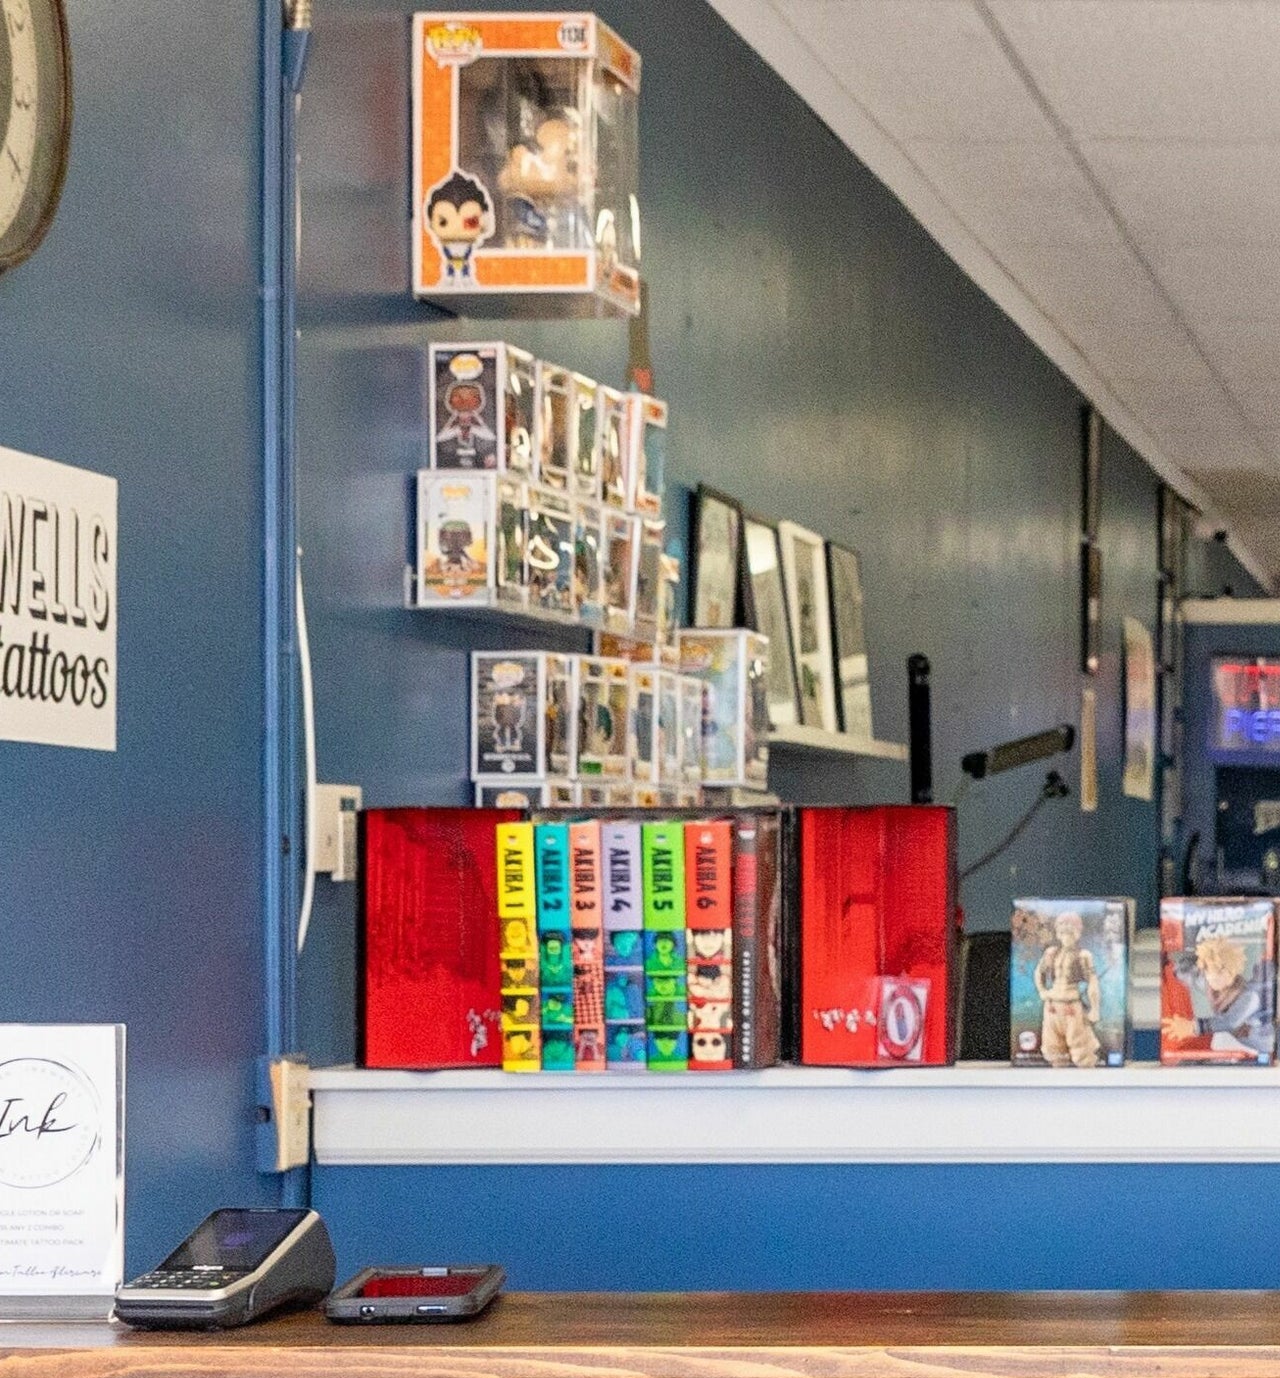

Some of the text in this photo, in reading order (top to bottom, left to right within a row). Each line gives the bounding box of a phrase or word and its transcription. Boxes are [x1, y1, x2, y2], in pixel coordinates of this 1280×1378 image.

[504, 848, 525, 895] AKIRA
[541, 849, 563, 912] AKIRA 2
[574, 848, 596, 912] AKIRA 3
[610, 848, 632, 913] AKIRA 4
[651, 848, 674, 911] AKIRA 5
[695, 846, 718, 910] AKIRA 6
[0, 1091, 78, 1140] Ink
